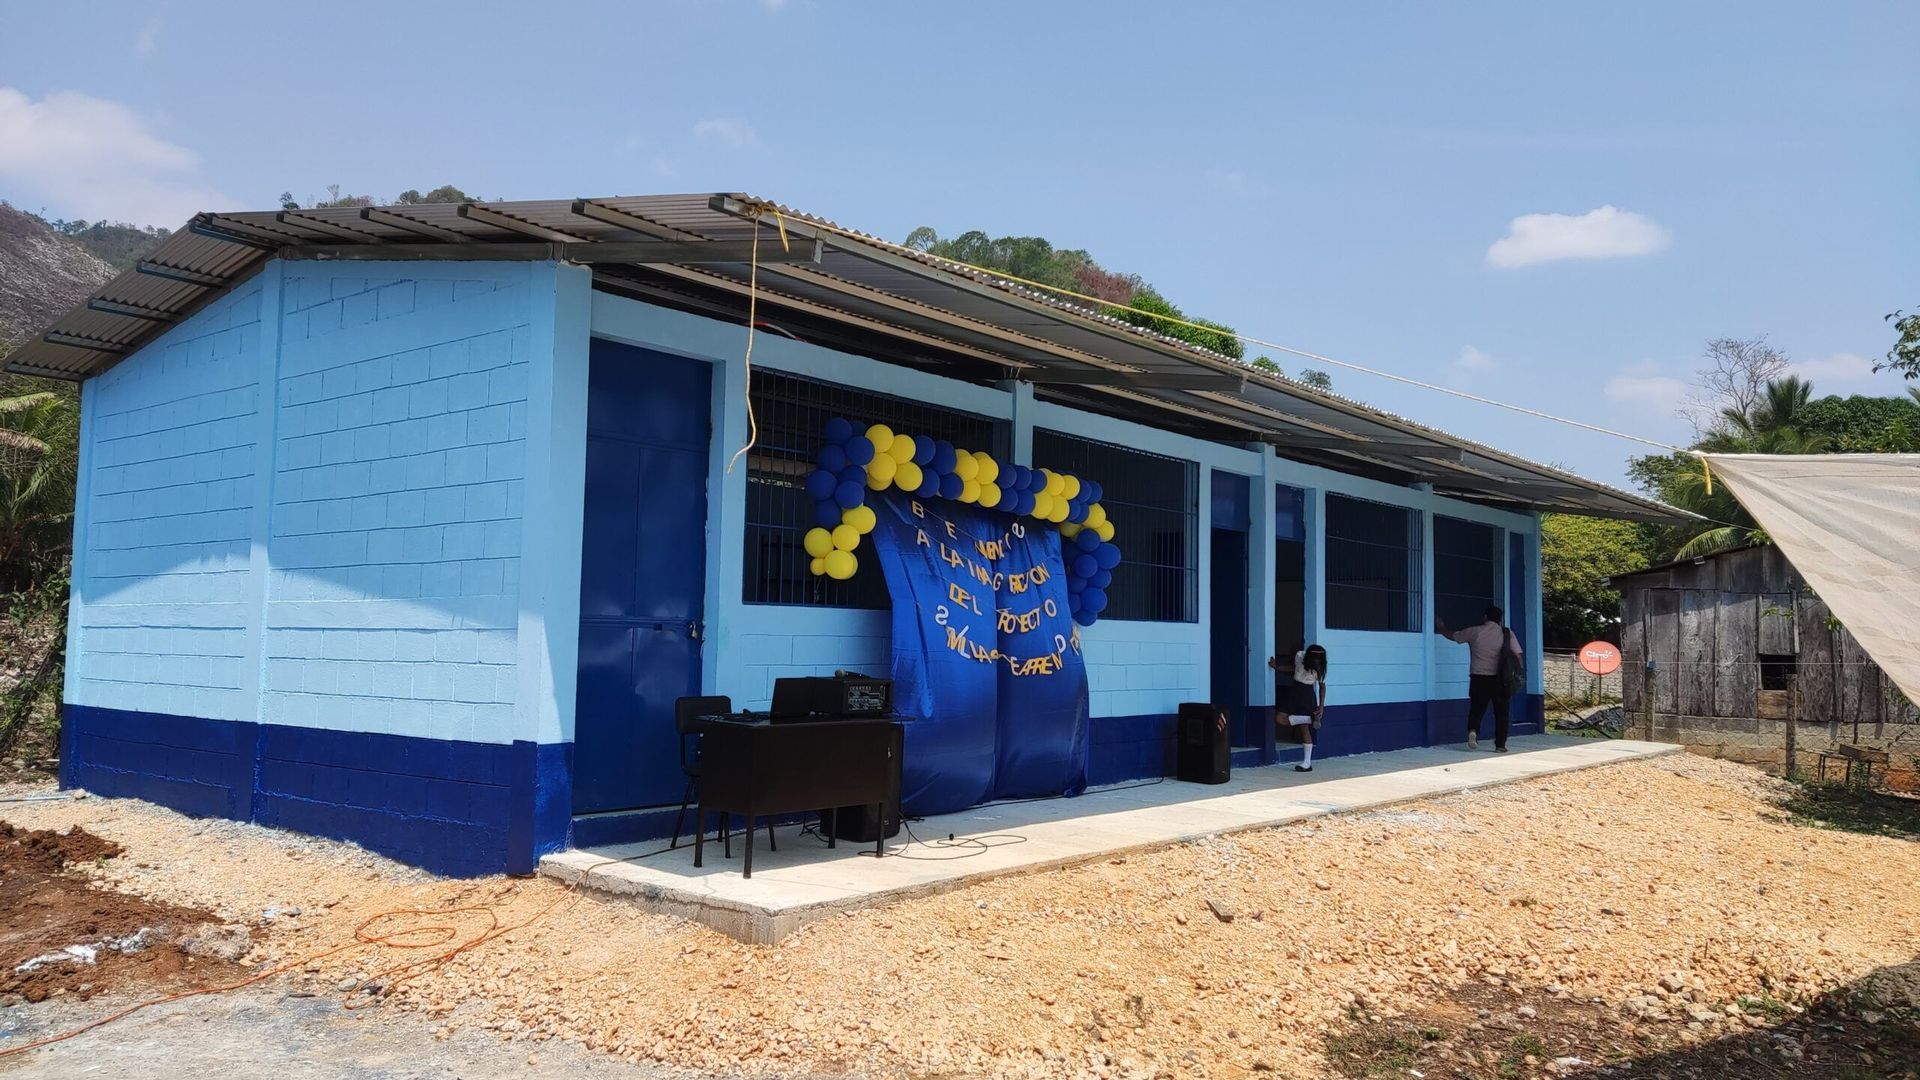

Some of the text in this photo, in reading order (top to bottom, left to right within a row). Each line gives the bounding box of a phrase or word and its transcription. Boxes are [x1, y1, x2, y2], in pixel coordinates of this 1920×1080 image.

[917, 528, 930, 548] A
[940, 542, 965, 569] LA
[949, 582, 983, 616] DEL
